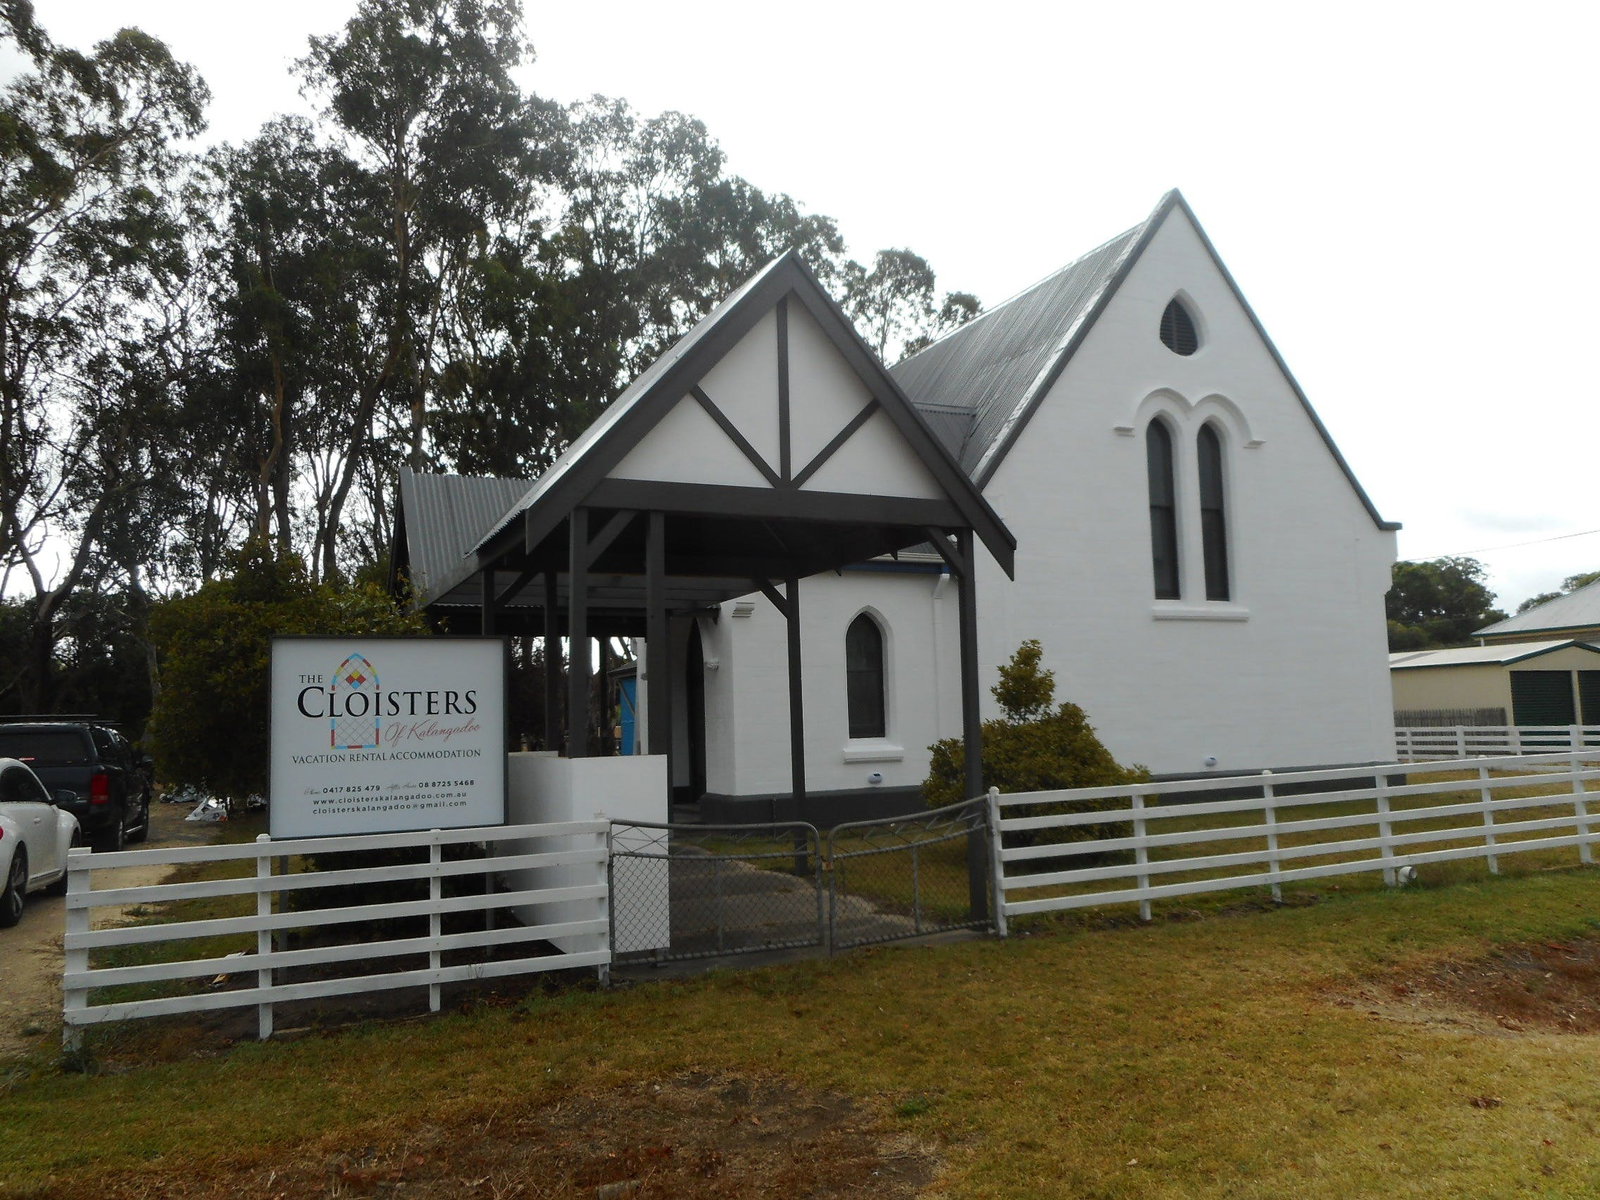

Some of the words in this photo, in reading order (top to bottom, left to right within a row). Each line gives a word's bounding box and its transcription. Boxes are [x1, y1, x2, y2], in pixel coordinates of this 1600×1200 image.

[299, 674, 323, 684] THE
[297, 686, 477, 718] CLOISTERS
[384, 722, 407, 747] Of
[407, 718, 481, 742] Kalangadoo
[292, 754, 346, 765] VACATION
[349, 752, 387, 763] RENTAL
[389, 749, 481, 761] ACCOMMODATION
[322, 786, 344, 794] 0417
[346, 785, 362, 793] 825
[364, 784, 381, 792] 479
[312, 792, 467, 805] www.cloisterskalangadoo.com.au
[312, 800, 467, 815] cloisterskalangadoo@gmail.com
